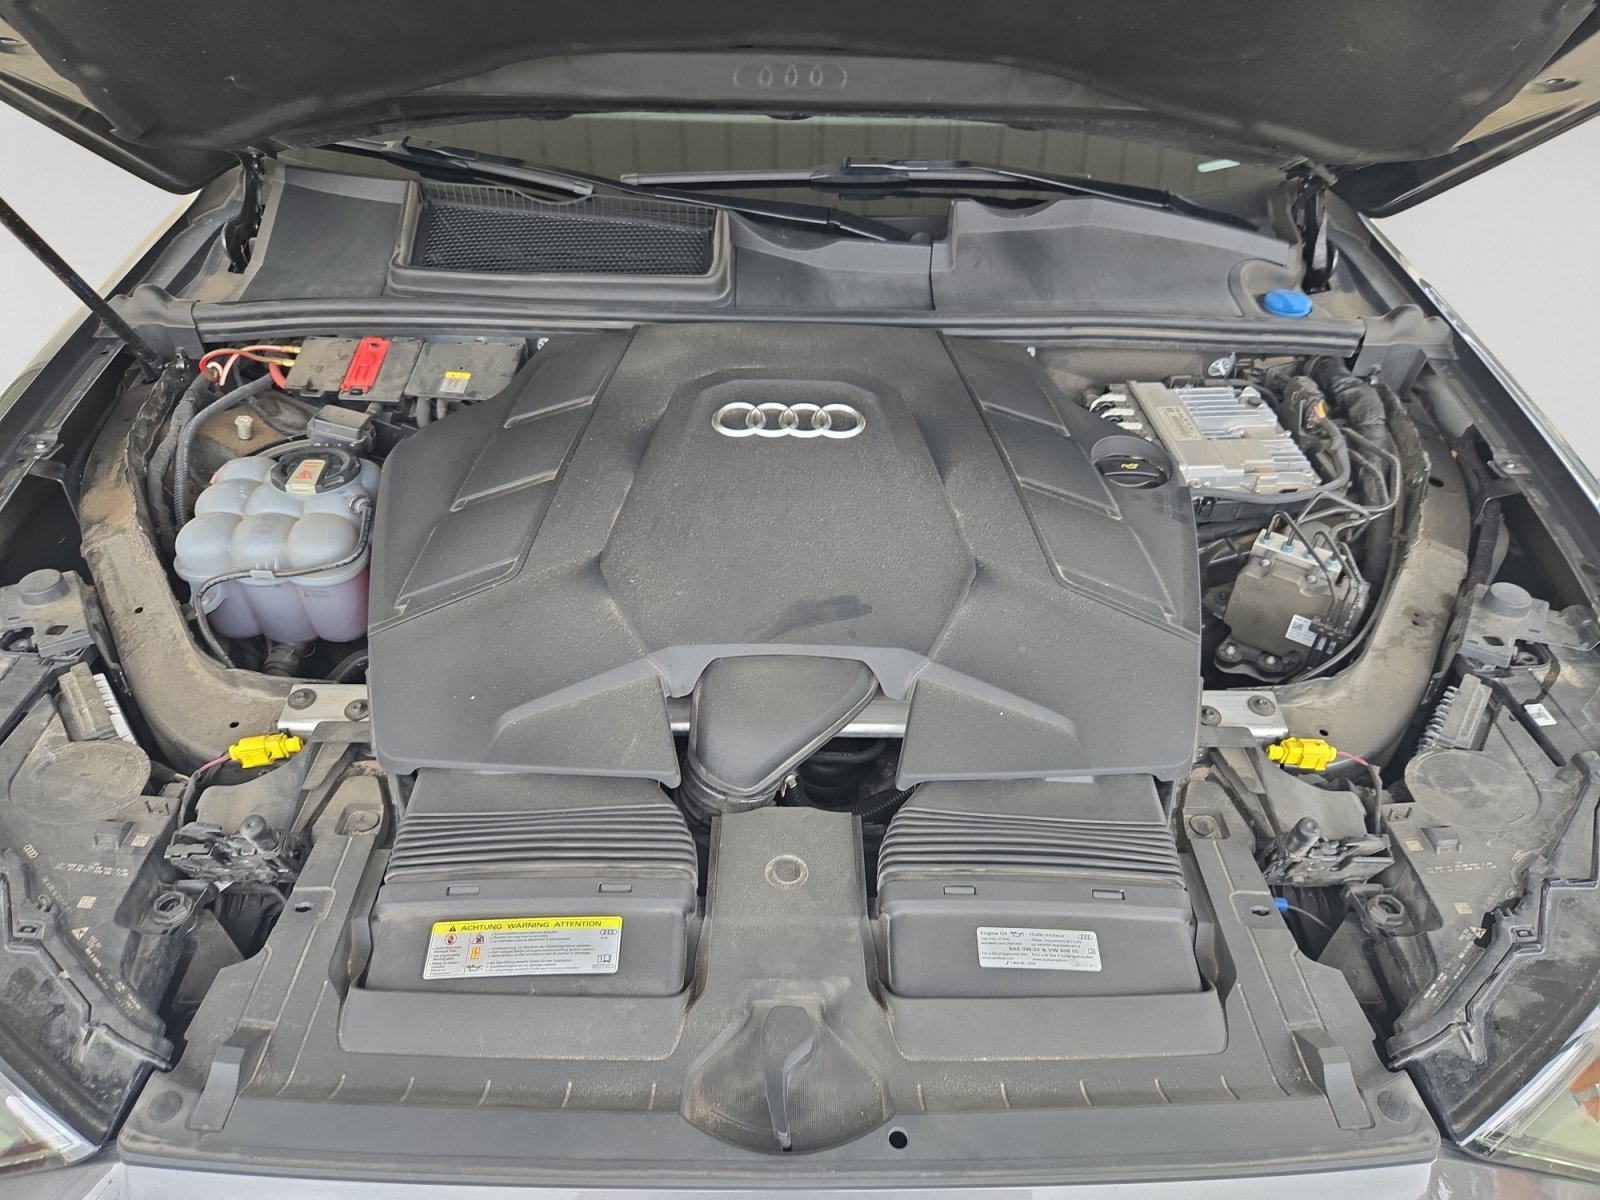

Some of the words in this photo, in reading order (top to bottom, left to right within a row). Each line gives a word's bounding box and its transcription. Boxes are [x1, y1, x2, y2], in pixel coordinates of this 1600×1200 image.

[461, 923, 503, 932] ACHTUNG
[507, 922, 550, 930] WARNING
[553, 920, 602, 928] ATTENTION
